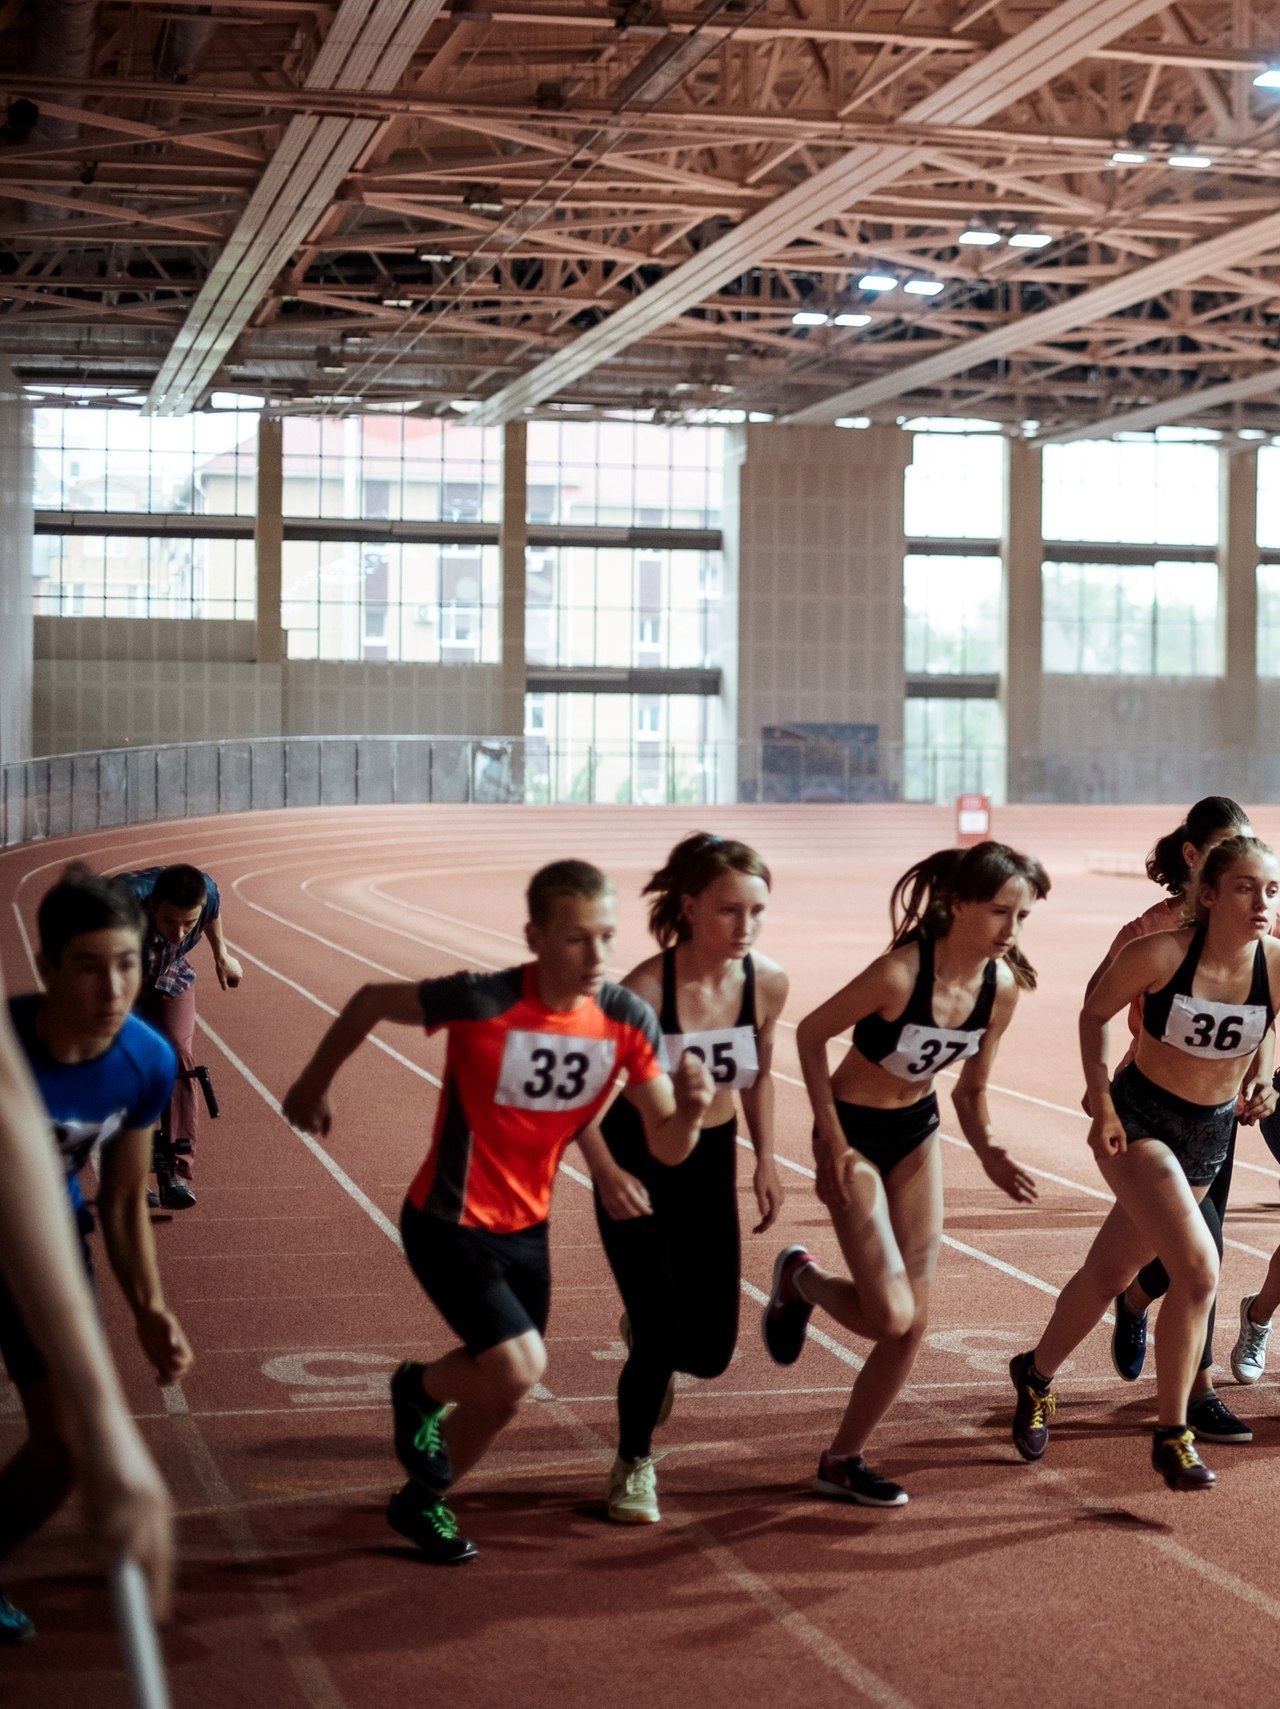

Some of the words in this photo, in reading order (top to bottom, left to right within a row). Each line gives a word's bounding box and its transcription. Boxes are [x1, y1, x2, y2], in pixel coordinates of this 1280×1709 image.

[1184, 1012, 1244, 1051] 36
[523, 1048, 590, 1100] 33
[682, 1041, 737, 1083] 5
[907, 1039, 968, 1074] 37
